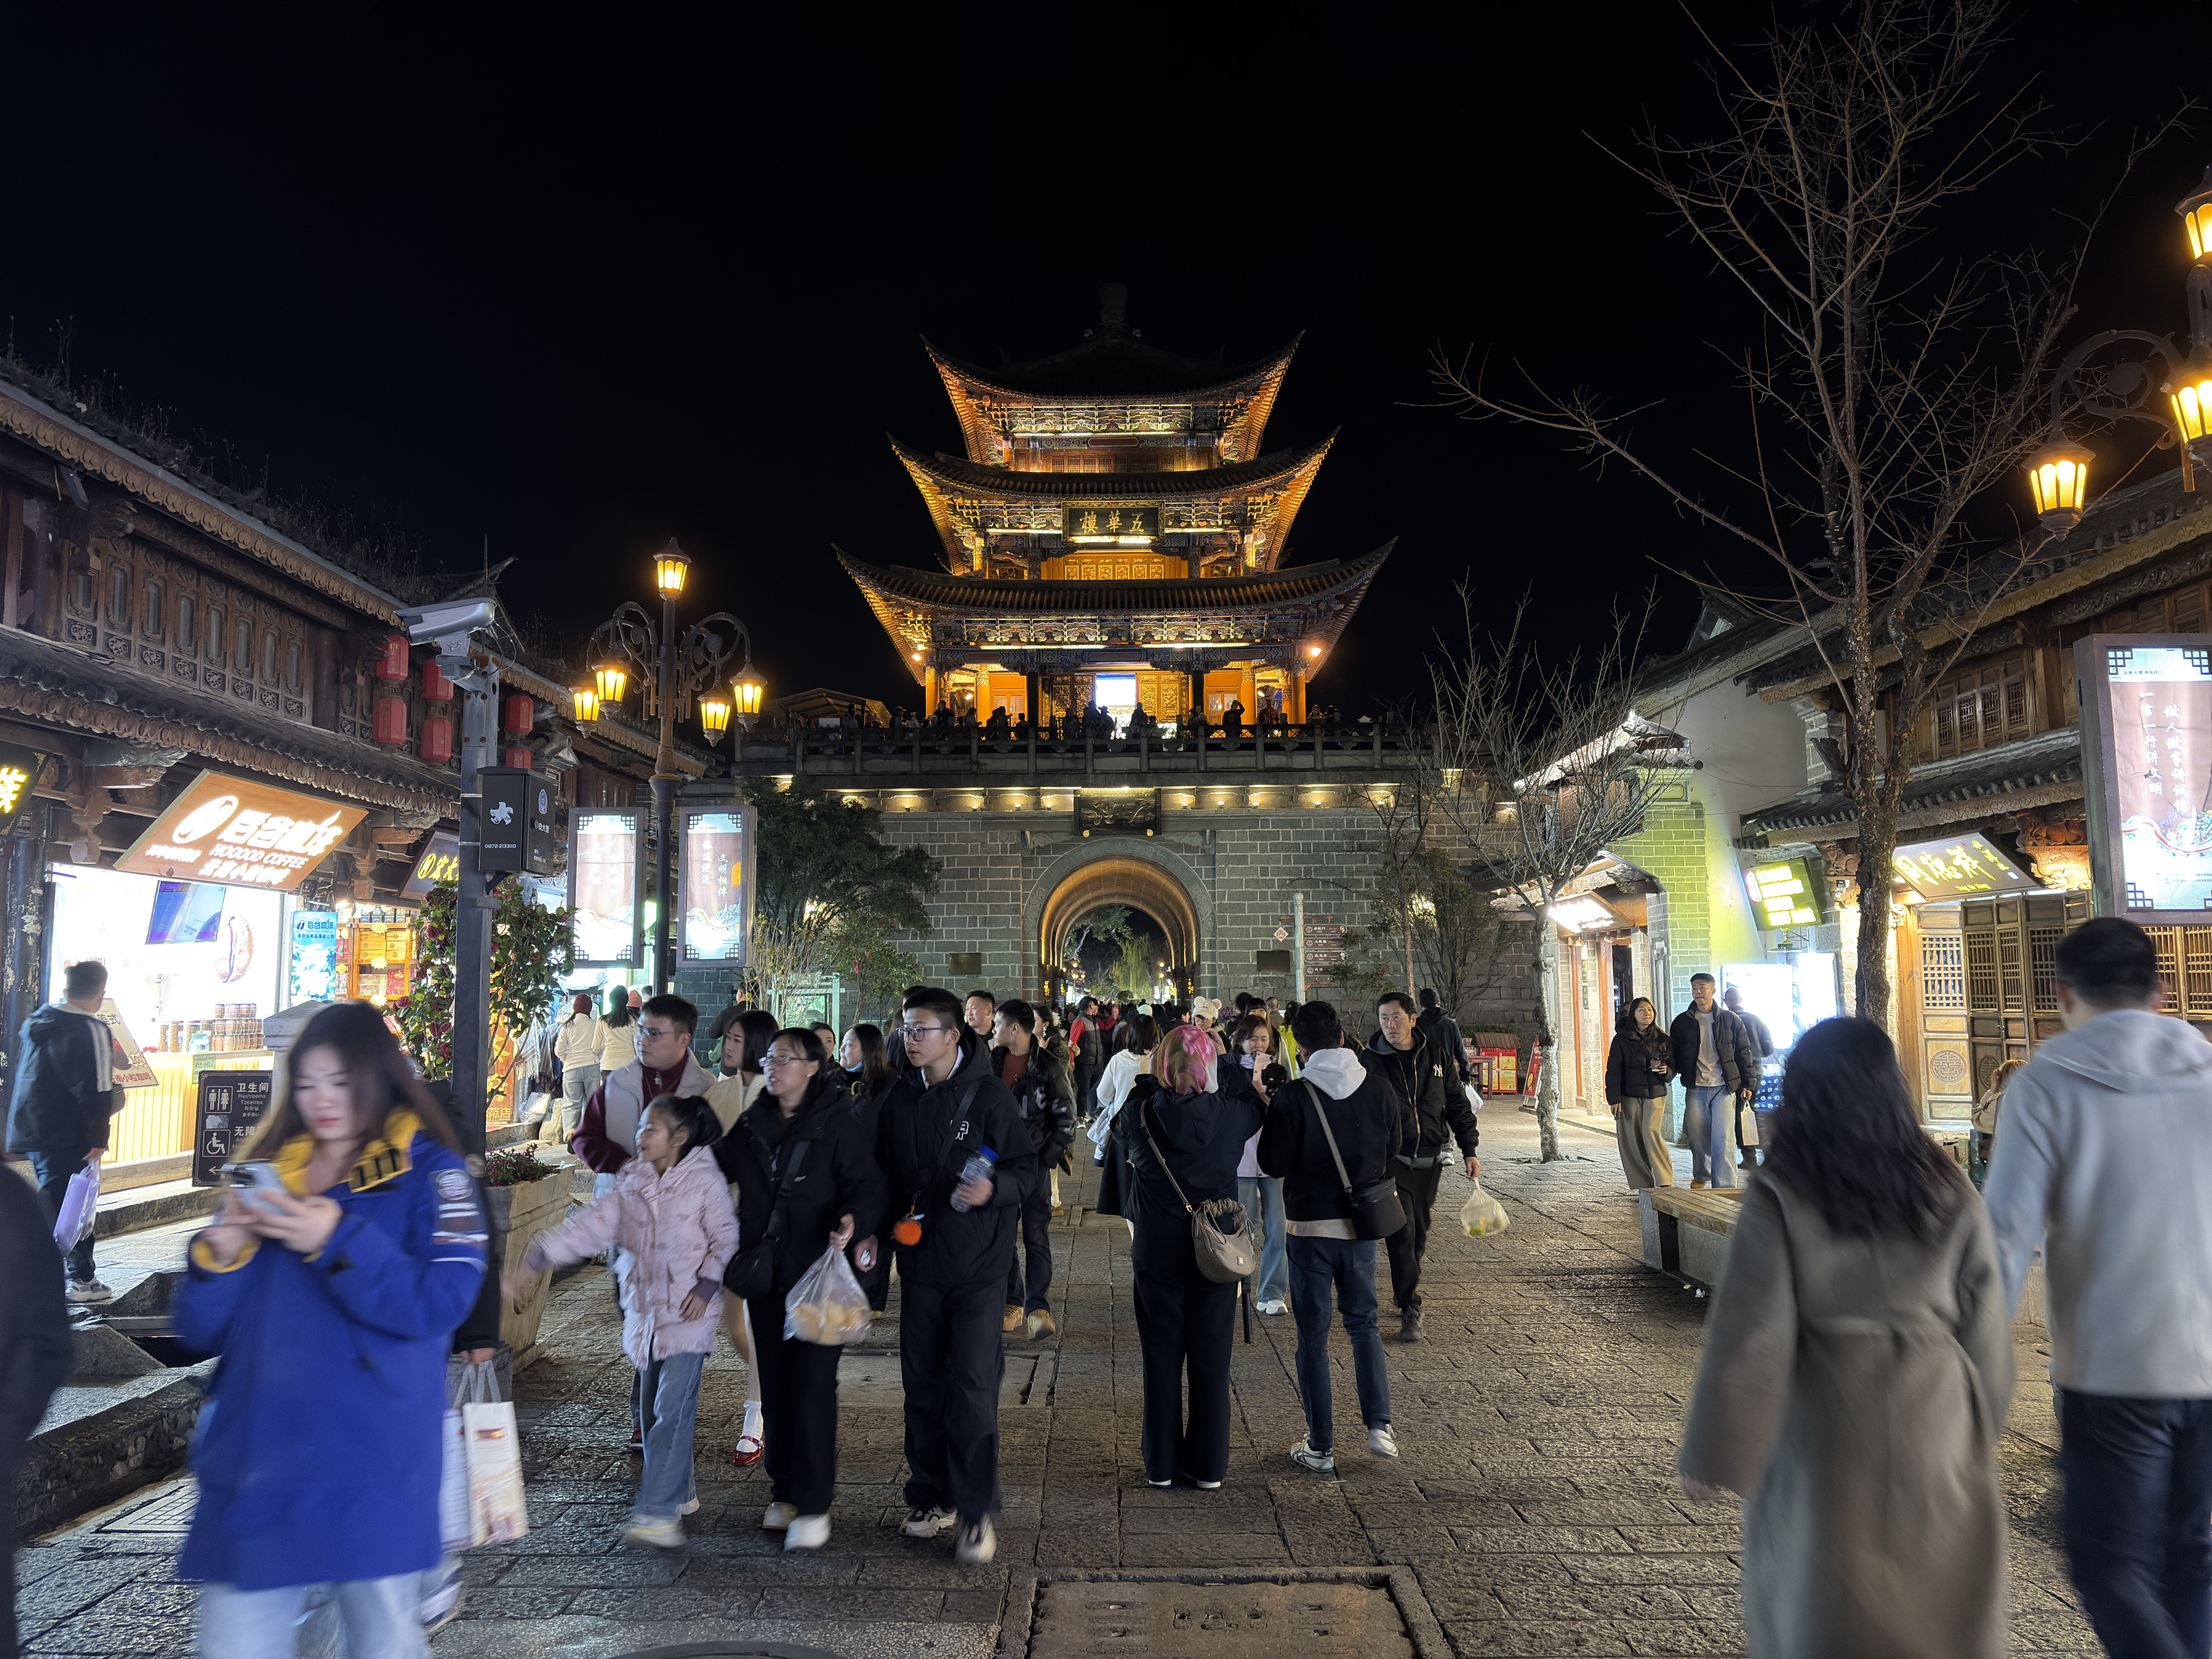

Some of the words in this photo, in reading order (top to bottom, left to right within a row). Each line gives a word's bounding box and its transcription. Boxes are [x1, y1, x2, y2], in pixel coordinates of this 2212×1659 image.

[1079, 509, 1144, 534] 五華樓
[2139, 692, 2163, 796] 一言一行讲文明
[536, 822, 550, 834] 安大理
[209, 844, 265, 863] HOGOOD
[263, 852, 309, 869] COFFEE
[717, 853, 728, 898] 文明相伴
[307, 918, 334, 929] 后谷咖啡
[1433, 1064, 1443, 1078] NY
[237, 1082, 269, 1093] 卫生间
[487, 1107, 511, 1121] 范店
[234, 1126, 257, 1136] 无障
